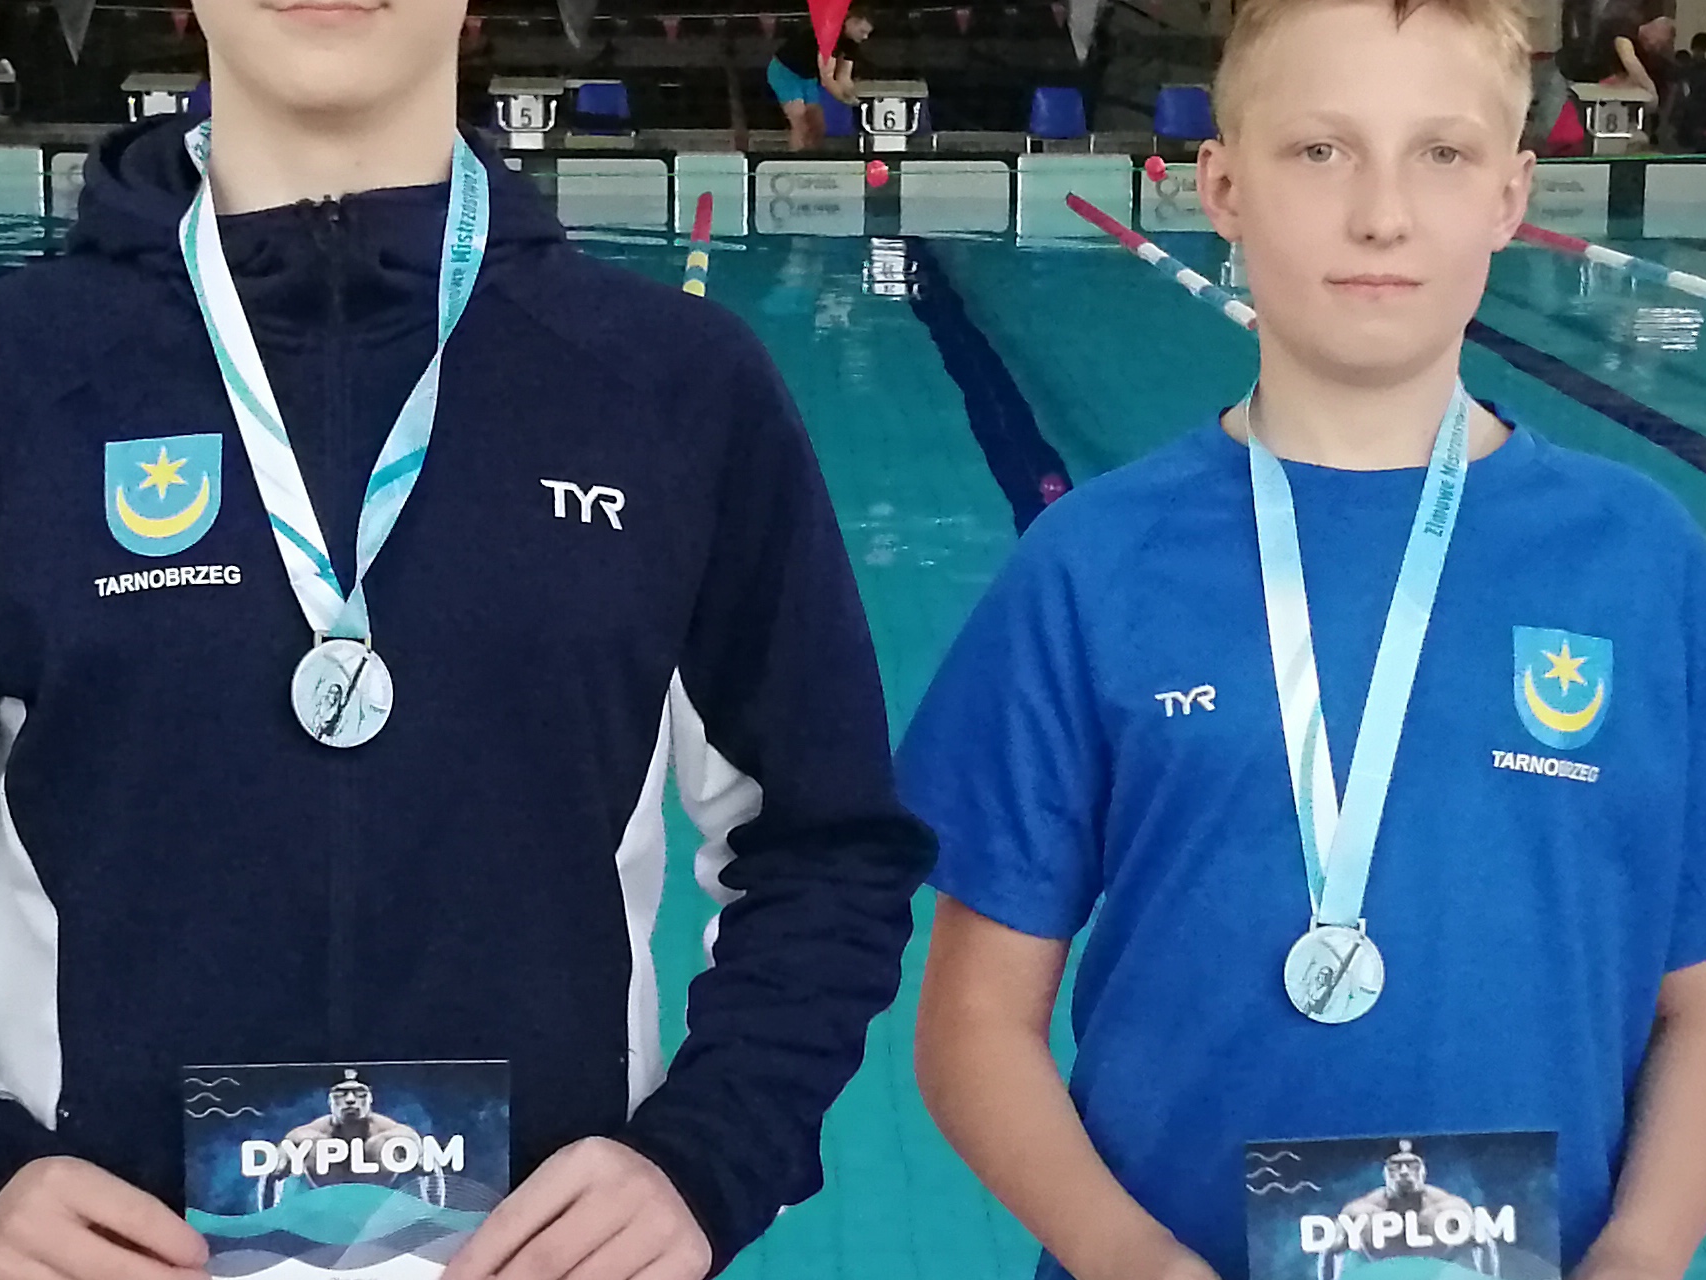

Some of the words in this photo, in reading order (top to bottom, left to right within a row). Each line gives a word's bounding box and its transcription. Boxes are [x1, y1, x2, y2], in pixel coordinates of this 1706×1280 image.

[520, 108, 532, 127] 5
[884, 111, 896, 131] 6
[541, 479, 626, 530] TYR
[94, 565, 241, 597] TARNOBRZEG
[1155, 685, 1216, 717] TYR
[241, 1134, 464, 1177] DYPLOM
[1299, 1205, 1516, 1253] DYPLOM
